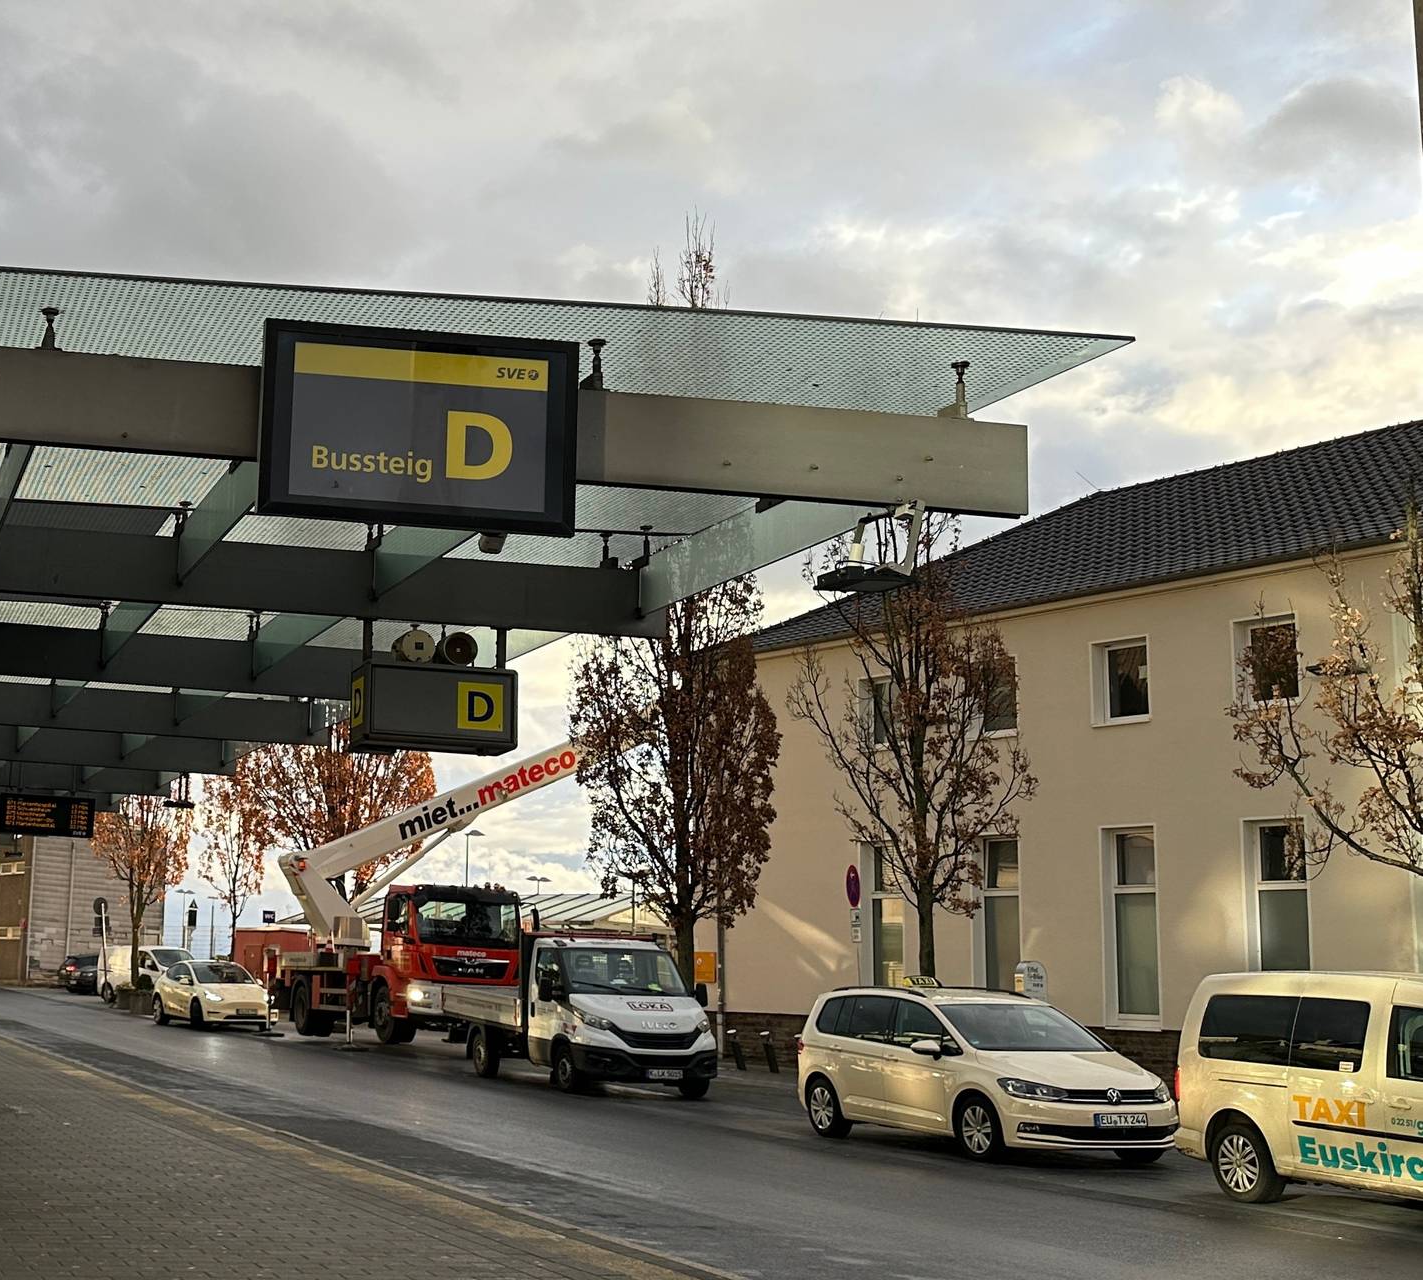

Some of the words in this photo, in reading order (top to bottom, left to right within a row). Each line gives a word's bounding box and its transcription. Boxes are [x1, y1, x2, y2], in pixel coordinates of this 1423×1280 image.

[496, 367, 526, 381] SVE
[311, 445, 433, 483] Bussteig
[445, 410, 513, 480] D
[467, 691, 494, 722] D
[457, 949, 487, 958] mateco
[641, 1020, 678, 1030] IVECO
[1292, 1094, 1366, 1128] TAXI
[1100, 1114, 1113, 1124] EU
[1118, 1114, 1130, 1124] TX
[1130, 1115, 1146, 1125] 244
